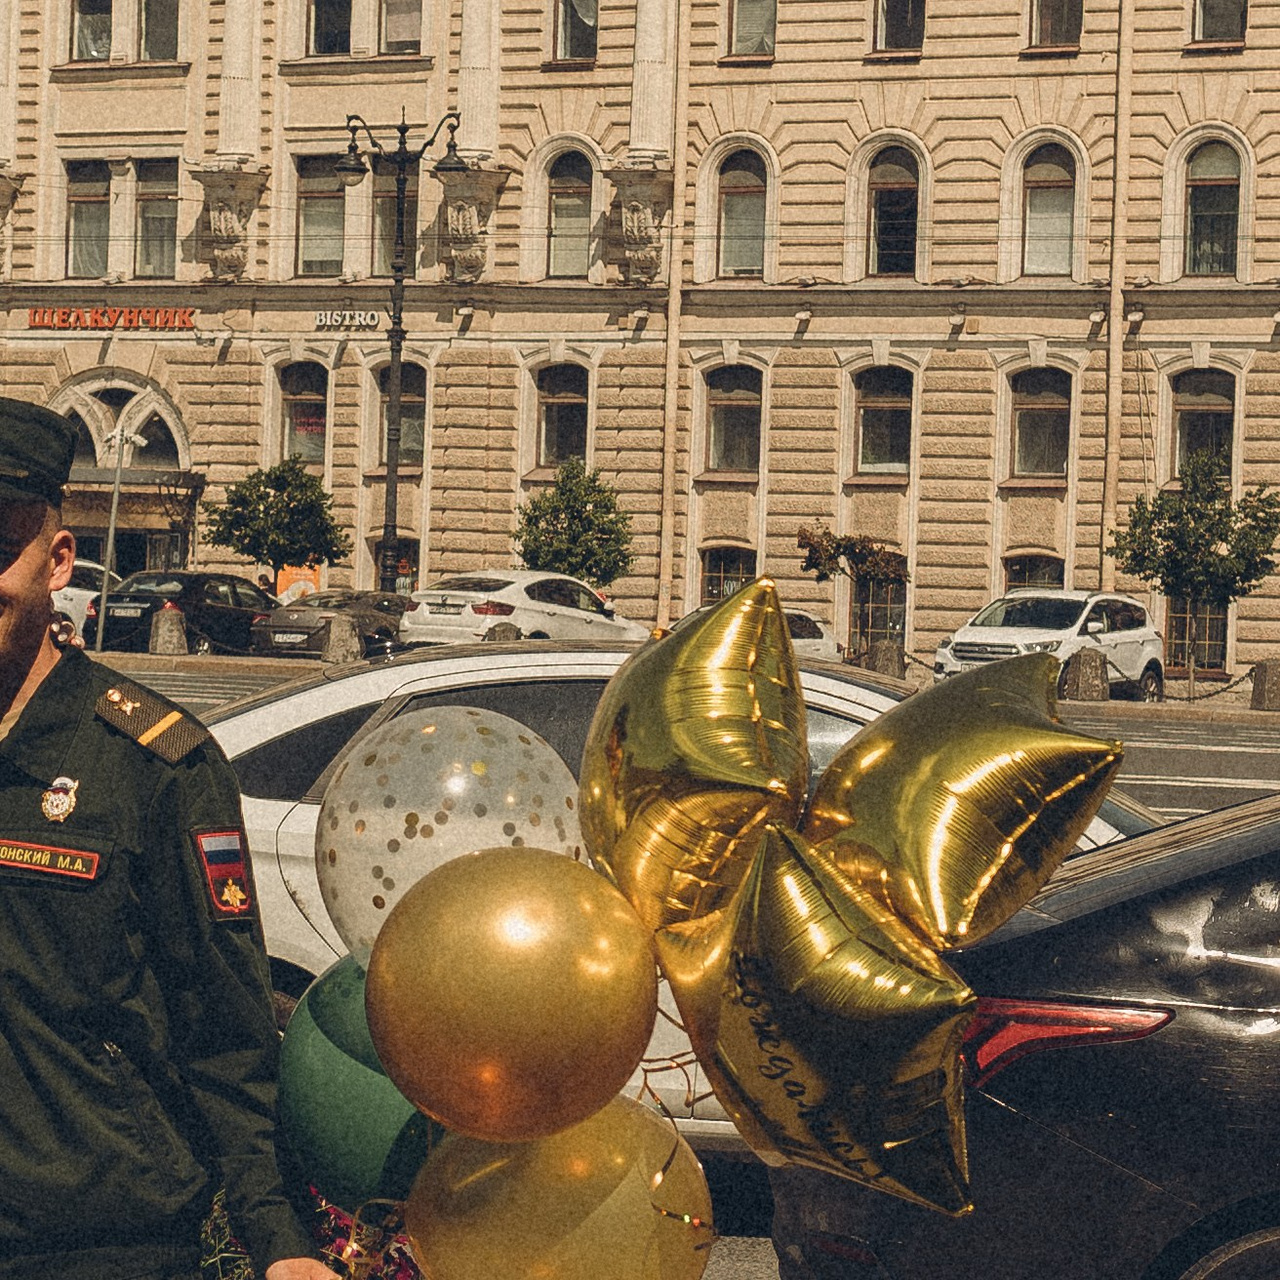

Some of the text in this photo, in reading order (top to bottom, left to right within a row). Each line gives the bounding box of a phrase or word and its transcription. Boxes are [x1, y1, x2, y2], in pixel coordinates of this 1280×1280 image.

[28, 308, 195, 328] ЩЕЛКУНЧИК
[316, 310, 378, 326] BISTRO
[57, 855, 86, 872] М.А.
